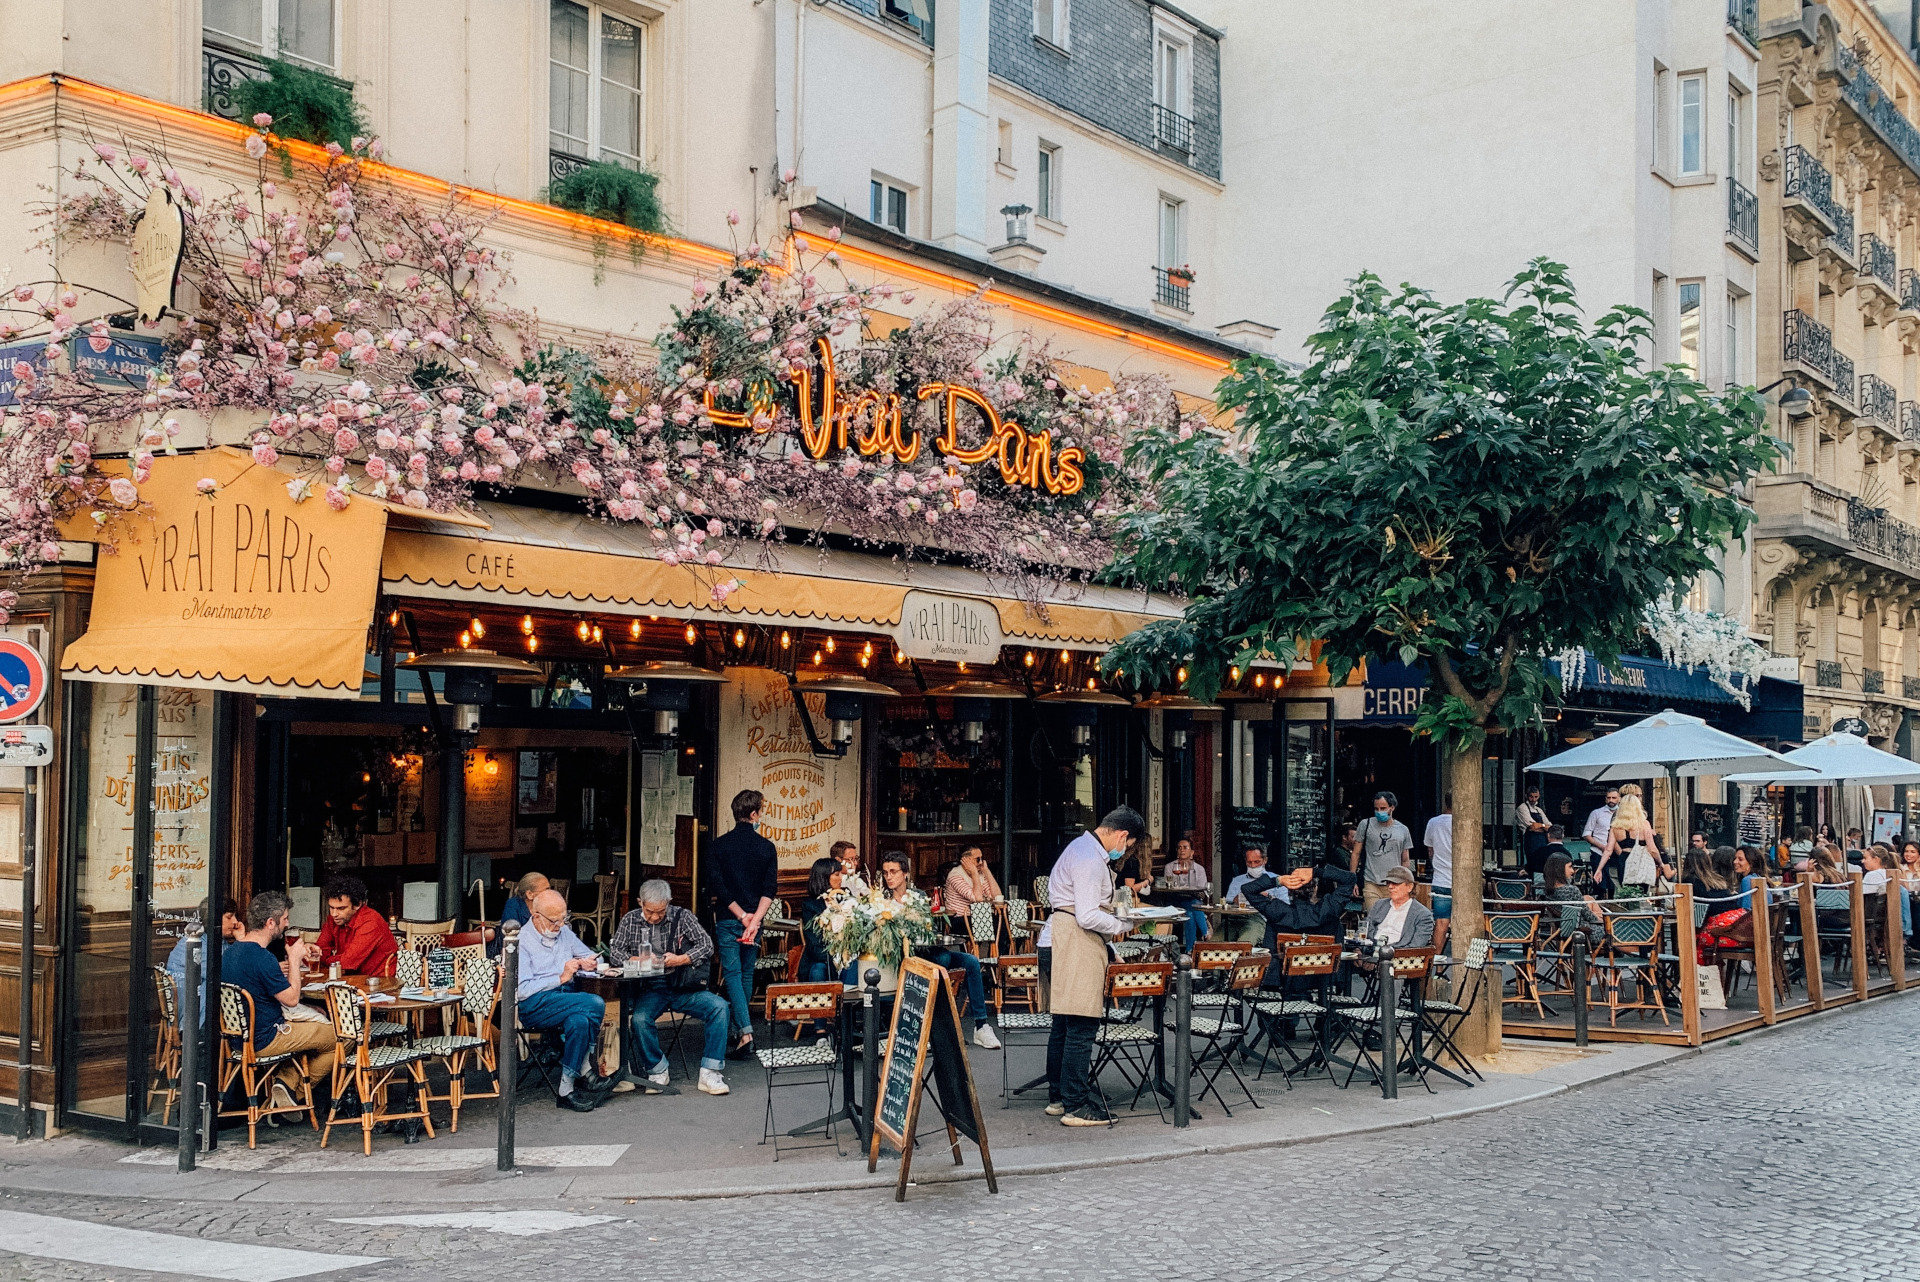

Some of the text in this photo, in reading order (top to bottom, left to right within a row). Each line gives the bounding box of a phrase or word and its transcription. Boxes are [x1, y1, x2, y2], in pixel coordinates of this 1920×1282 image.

[115, 344, 149, 359] RUE
[790, 336, 920, 463] Vrai
[138, 503, 332, 593] VRAI PARIS
[466, 553, 515, 578] CAFÉ
[182, 597, 273, 620] Montmartre
[909, 602, 990, 646] VRAI PARIS
[1597, 664, 1607, 684] LE
[761, 768, 825, 789] PRODUITS FRAIS
[789, 785, 798, 799] &
[761, 797, 824, 821] FAIT MAISON
[760, 812, 837, 841] TOUTE HEURE
